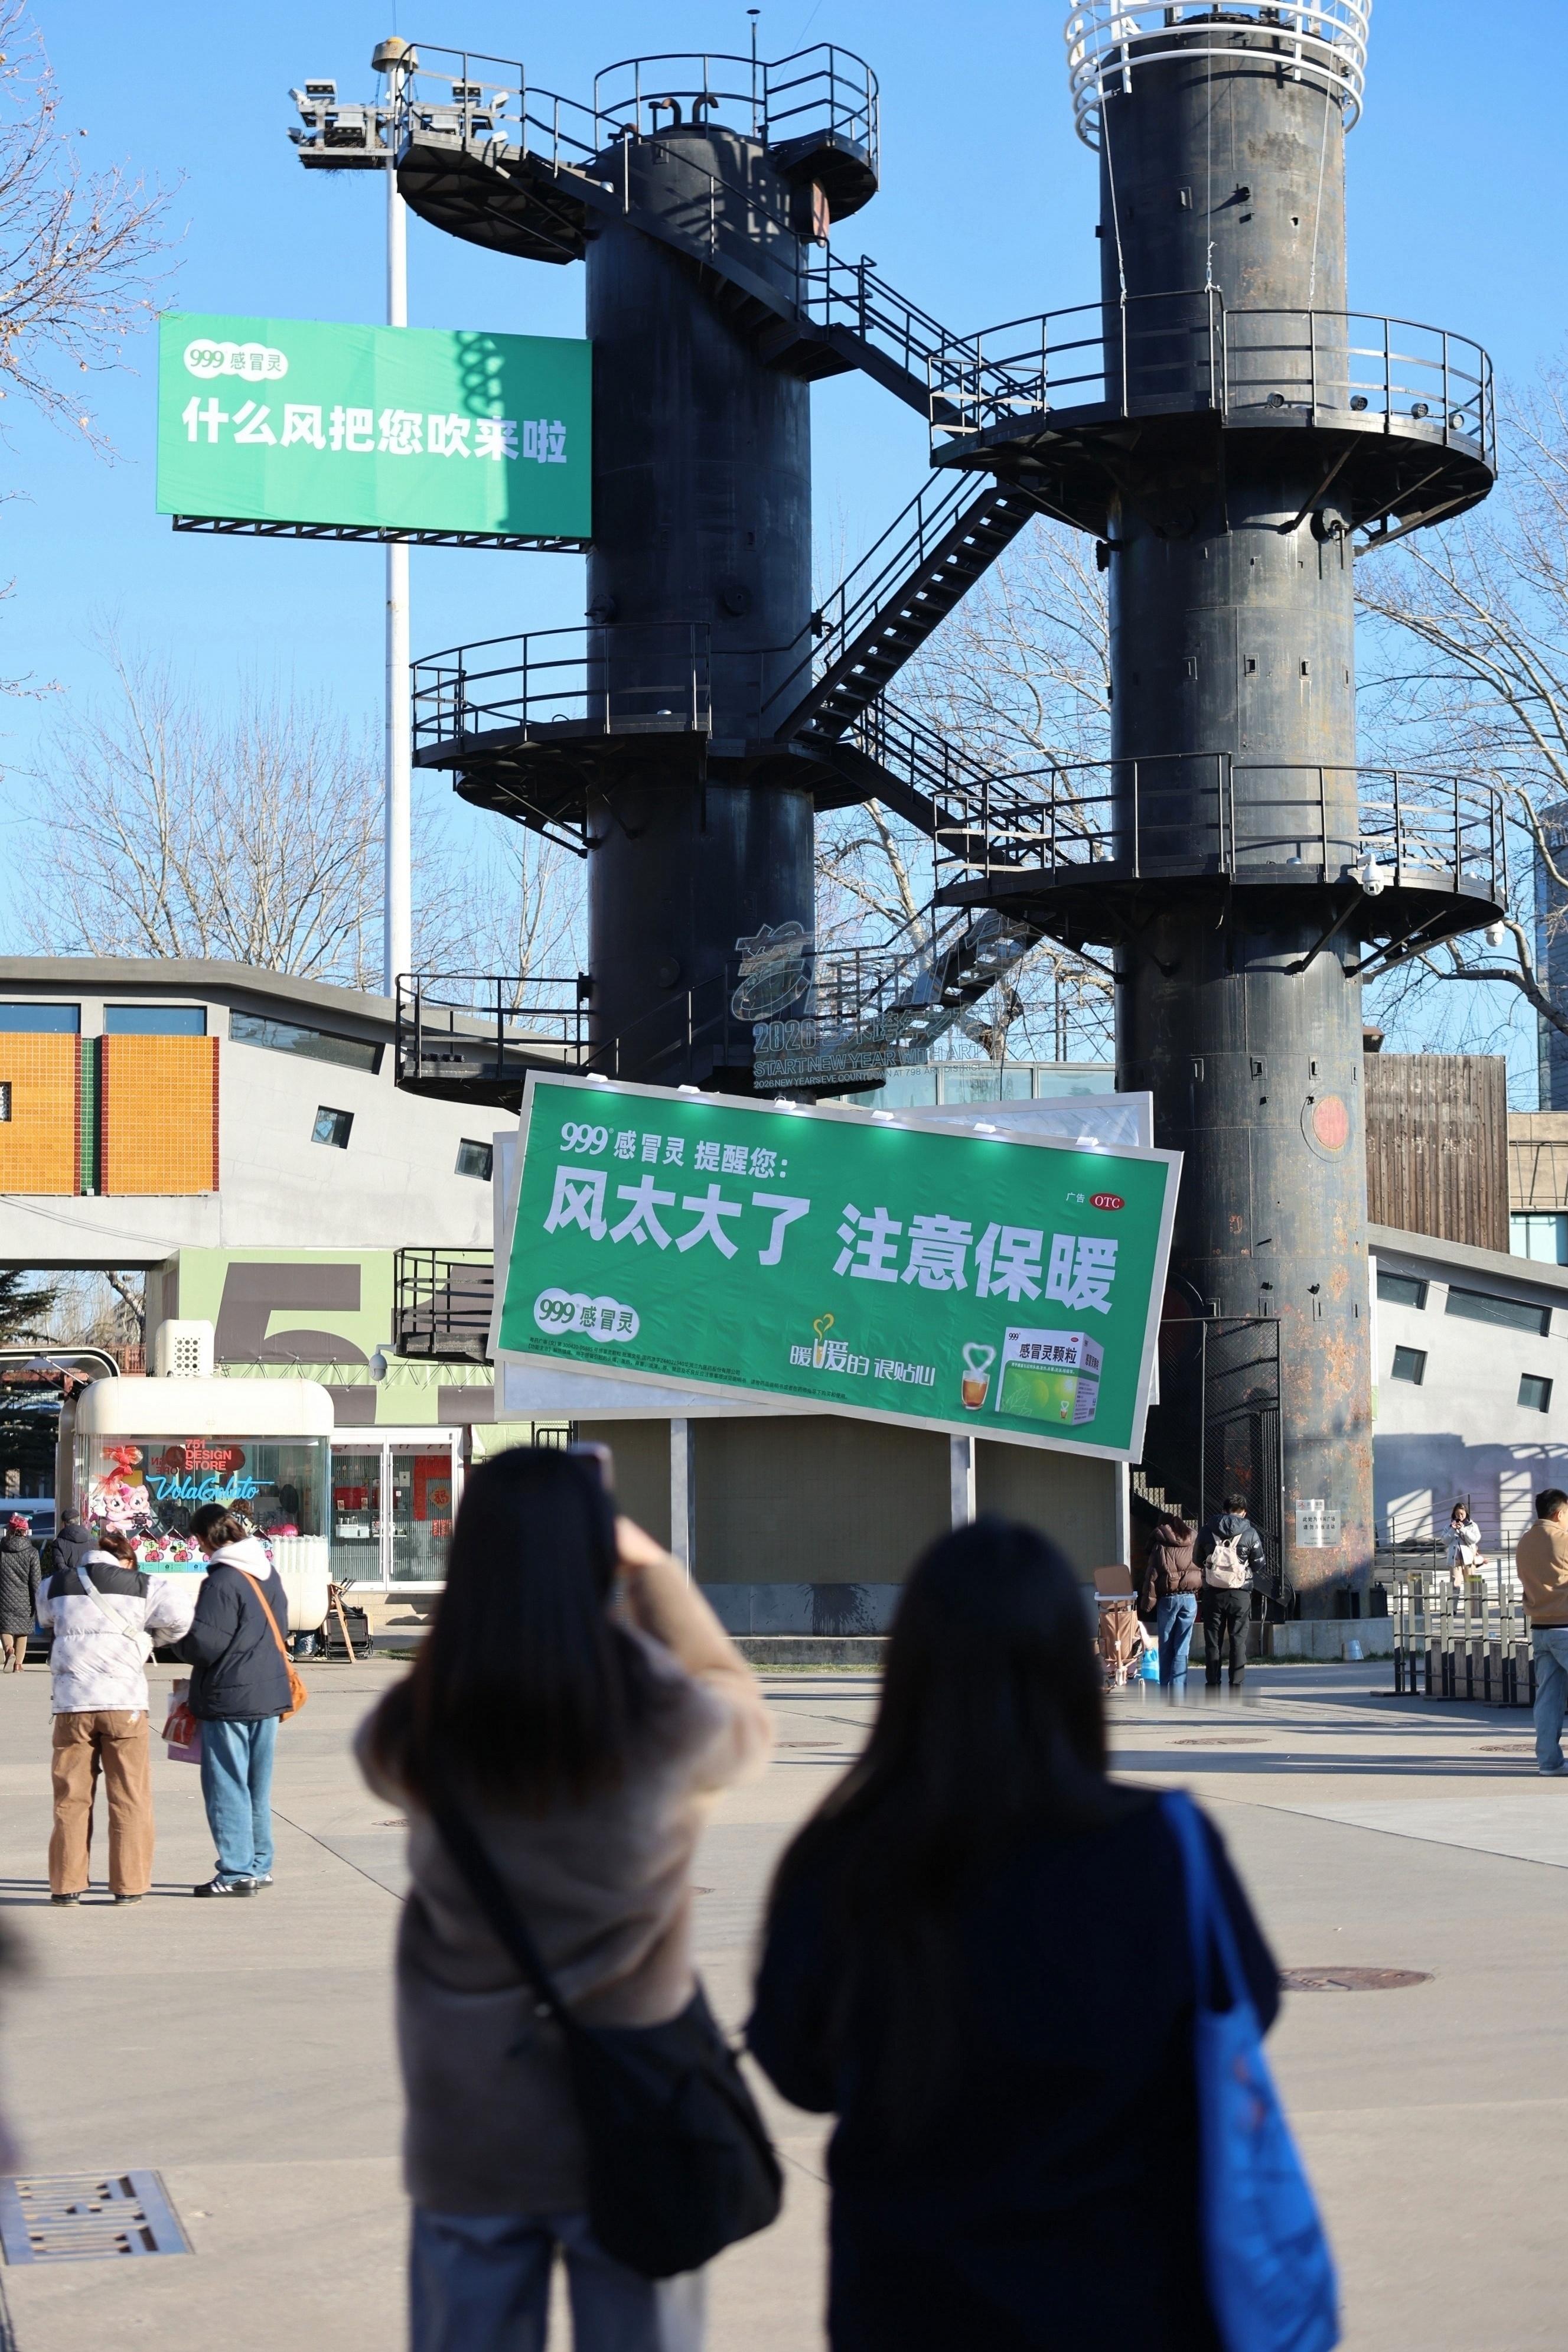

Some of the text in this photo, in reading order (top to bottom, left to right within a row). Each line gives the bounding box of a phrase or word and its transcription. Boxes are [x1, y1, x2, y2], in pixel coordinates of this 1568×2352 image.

[230, 351, 283, 372] 感冒灵
[181, 396, 568, 464] 什么风把您吹来啦
[754, 1043, 982, 1077] START NEW YEAR WITH ART
[754, 1080, 774, 1089] 2026
[775, 1079, 793, 1087] NEW
[822, 1074, 837, 1083] EVE
[838, 1070, 892, 1083] COUNTDOWN
[894, 1069, 904, 1077] AT
[906, 1068, 921, 1077] 798
[944, 1064, 982, 1073] DISTRICT
[614, 1130, 685, 1167] 感冒灵
[1065, 1192, 1085, 1204] 广告
[1094, 1196, 1120, 1208] OTC
[543, 1165, 1119, 1315] 风太大了 注意保暖
[579, 1306, 634, 1334] 感冒灵
[790, 1338, 937, 1386] 暖暖的 很贴心
[1019, 1343, 1078, 1364] 感冒灵颗粒
[185, 1439, 206, 1449] 751
[185, 1450, 232, 1460] DESIGN
[185, 1460, 227, 1470] STORE
